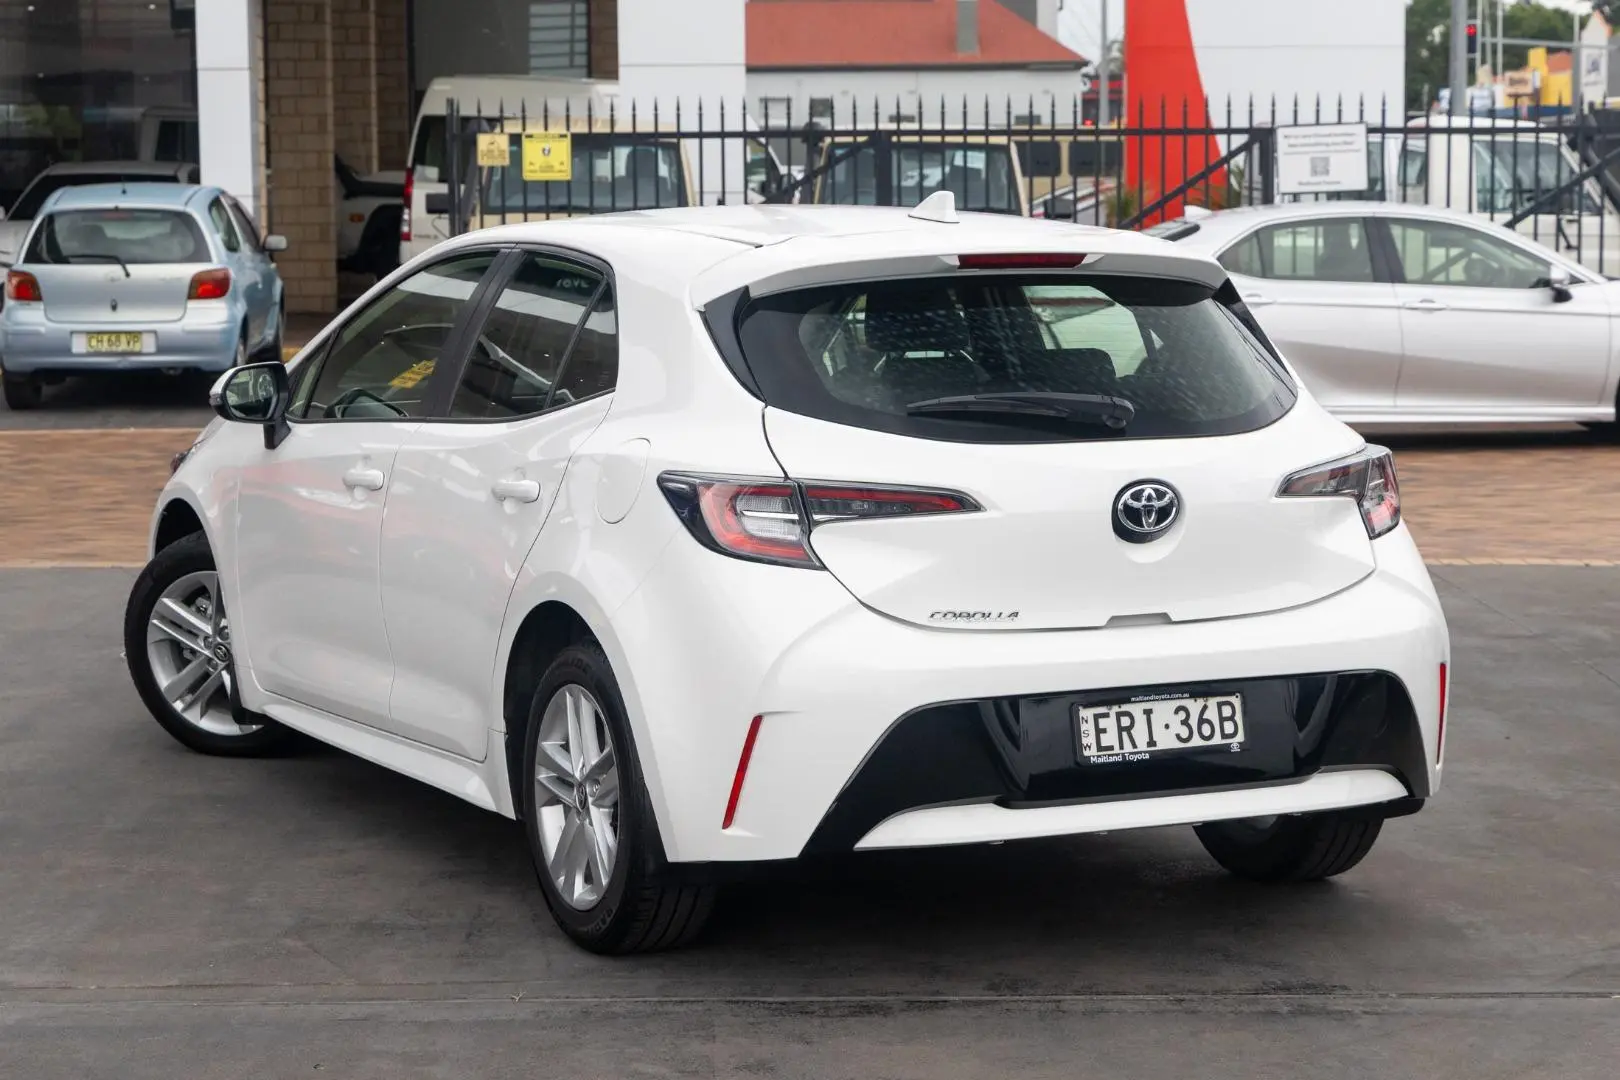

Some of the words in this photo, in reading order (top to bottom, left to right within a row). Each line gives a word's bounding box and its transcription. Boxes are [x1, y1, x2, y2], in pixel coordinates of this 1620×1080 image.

[1130, 692, 1190, 702] maitlandtoyota.com.au
[1090, 754, 1123, 764] Maitland
[1125, 752, 1150, 762] Toyota
